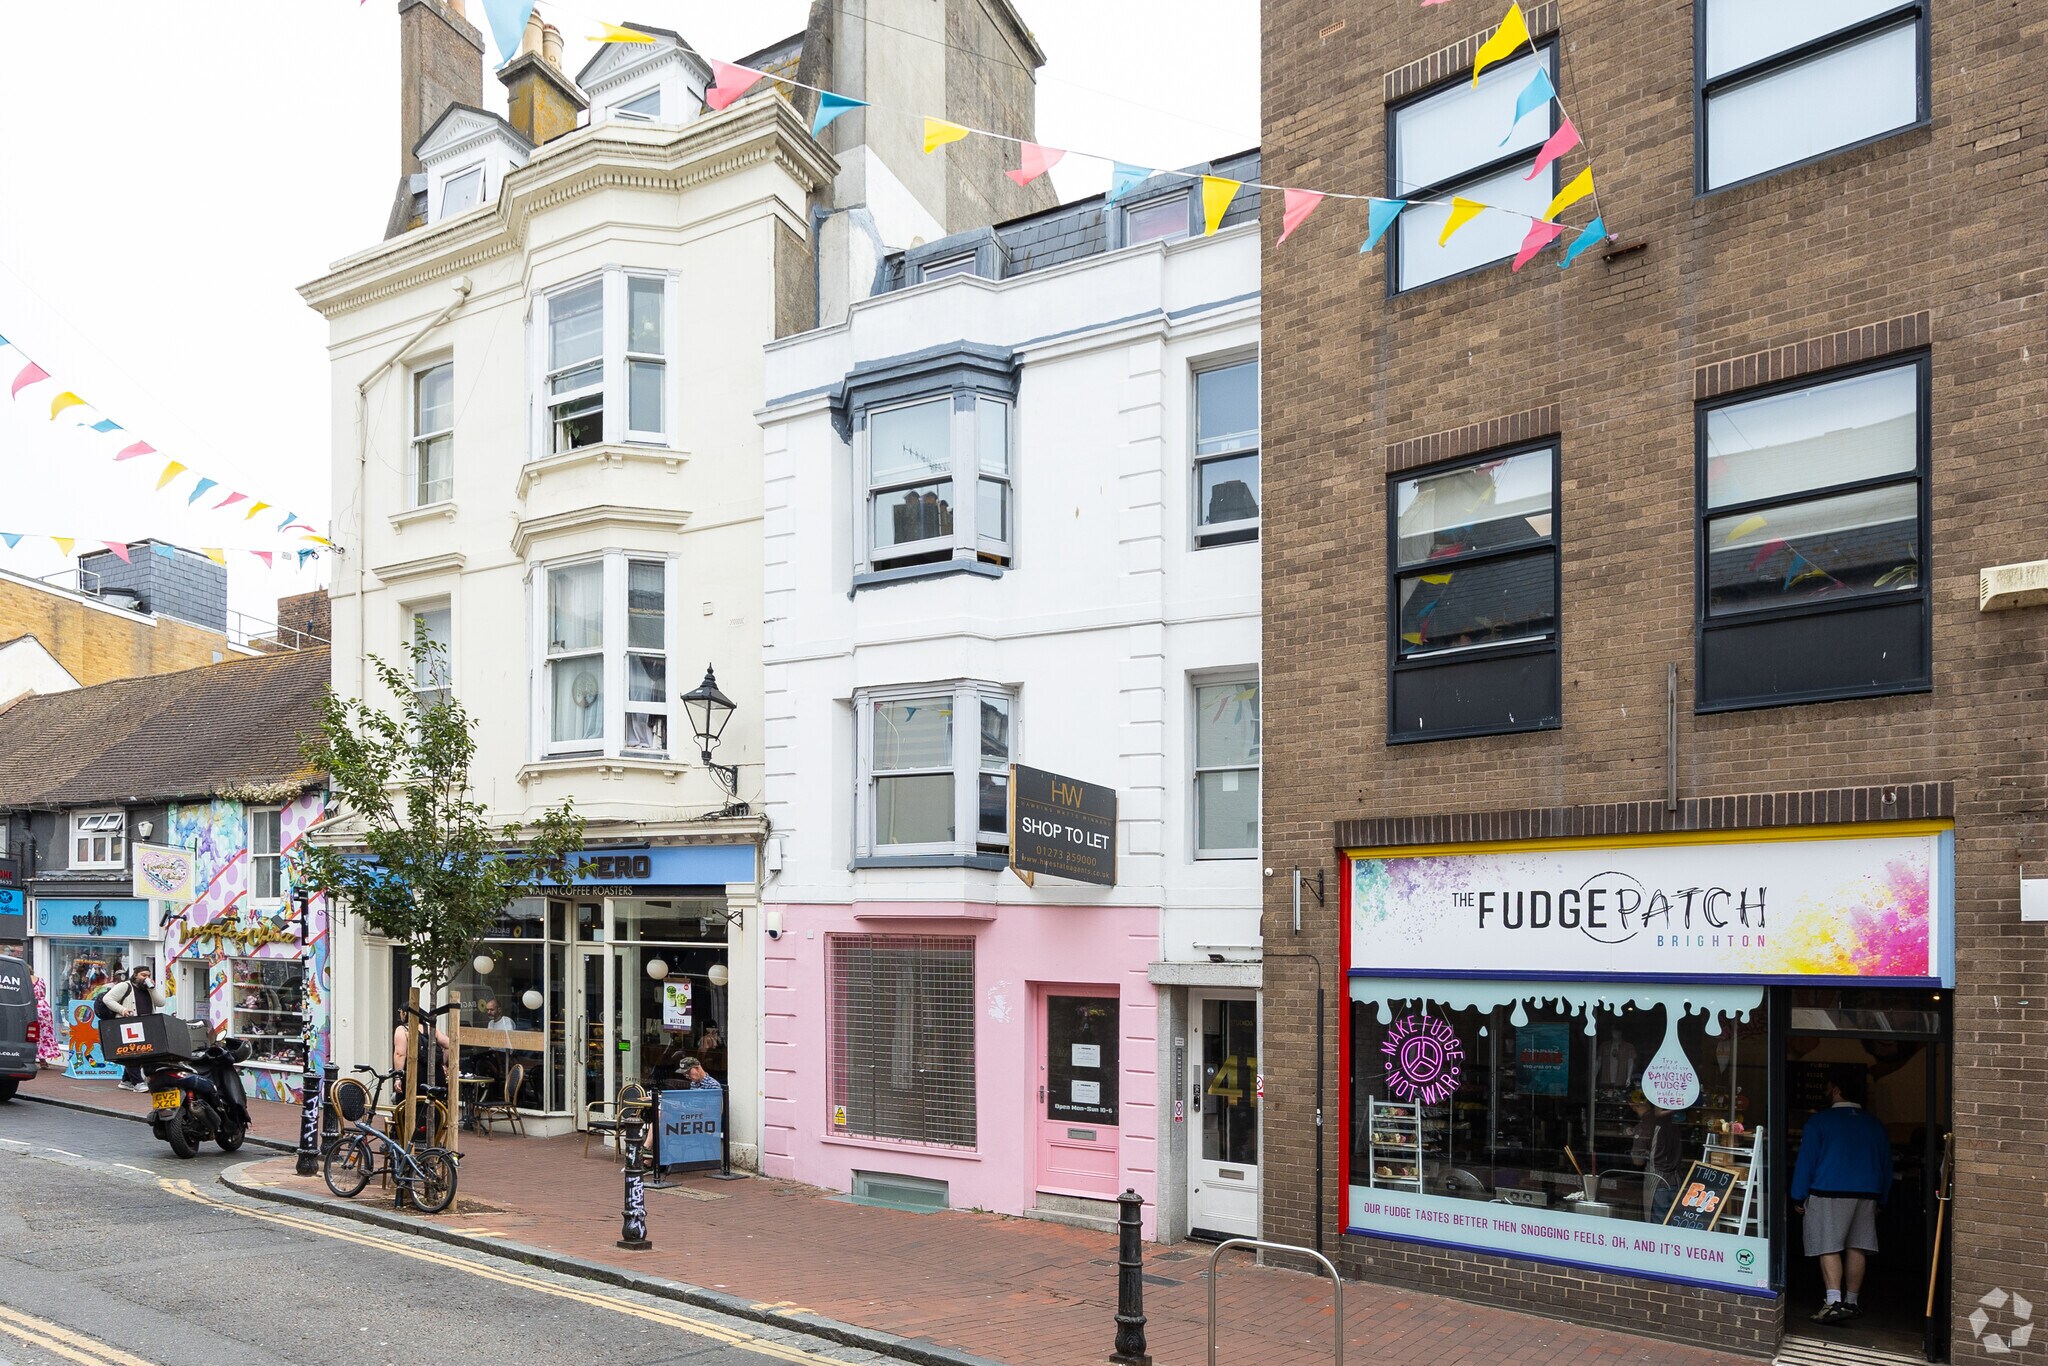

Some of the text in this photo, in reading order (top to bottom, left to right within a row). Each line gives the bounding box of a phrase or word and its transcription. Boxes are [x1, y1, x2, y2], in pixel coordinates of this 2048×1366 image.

[1051, 780, 1084, 809] HW
[1022, 817, 1109, 850] SHOP TO LET
[1036, 845, 1063, 860] 01273
[578, 855, 650, 879] NERO
[559, 886, 590, 896] COFFEE
[592, 885, 633, 896] ROASTERS
[1451, 886, 1767, 930] THE FUDGE PATCH
[1657, 935, 1765, 947] BRIGHTON
[126, 1027, 139, 1039] L
[1380, 1015, 1464, 1061] MAKE FUDGE
[116, 1046, 129, 1054] GO
[136, 1044, 153, 1052] FAR
[1647, 1071, 1693, 1082] BANGING
[1385, 1071, 1460, 1105] NOT WAR
[1653, 1081, 1688, 1090] FUDGE
[155, 1091, 178, 1101] GV21
[1657, 1097, 1685, 1106] FREE!
[157, 1100, 176, 1108] XZC
[1054, 1103, 1071, 1111] Open
[1071, 1104, 1099, 1113] Mon-Sun
[665, 1120, 716, 1136] NERO
[1696, 1165, 1730, 1186] THIS IS
[1683, 1210, 1701, 1221] NOT
[1363, 1202, 1724, 1263] OUR FUDGE TASTES BETTER THEN SNOGGING FEELS. OH, AND IT'S VEGAN
